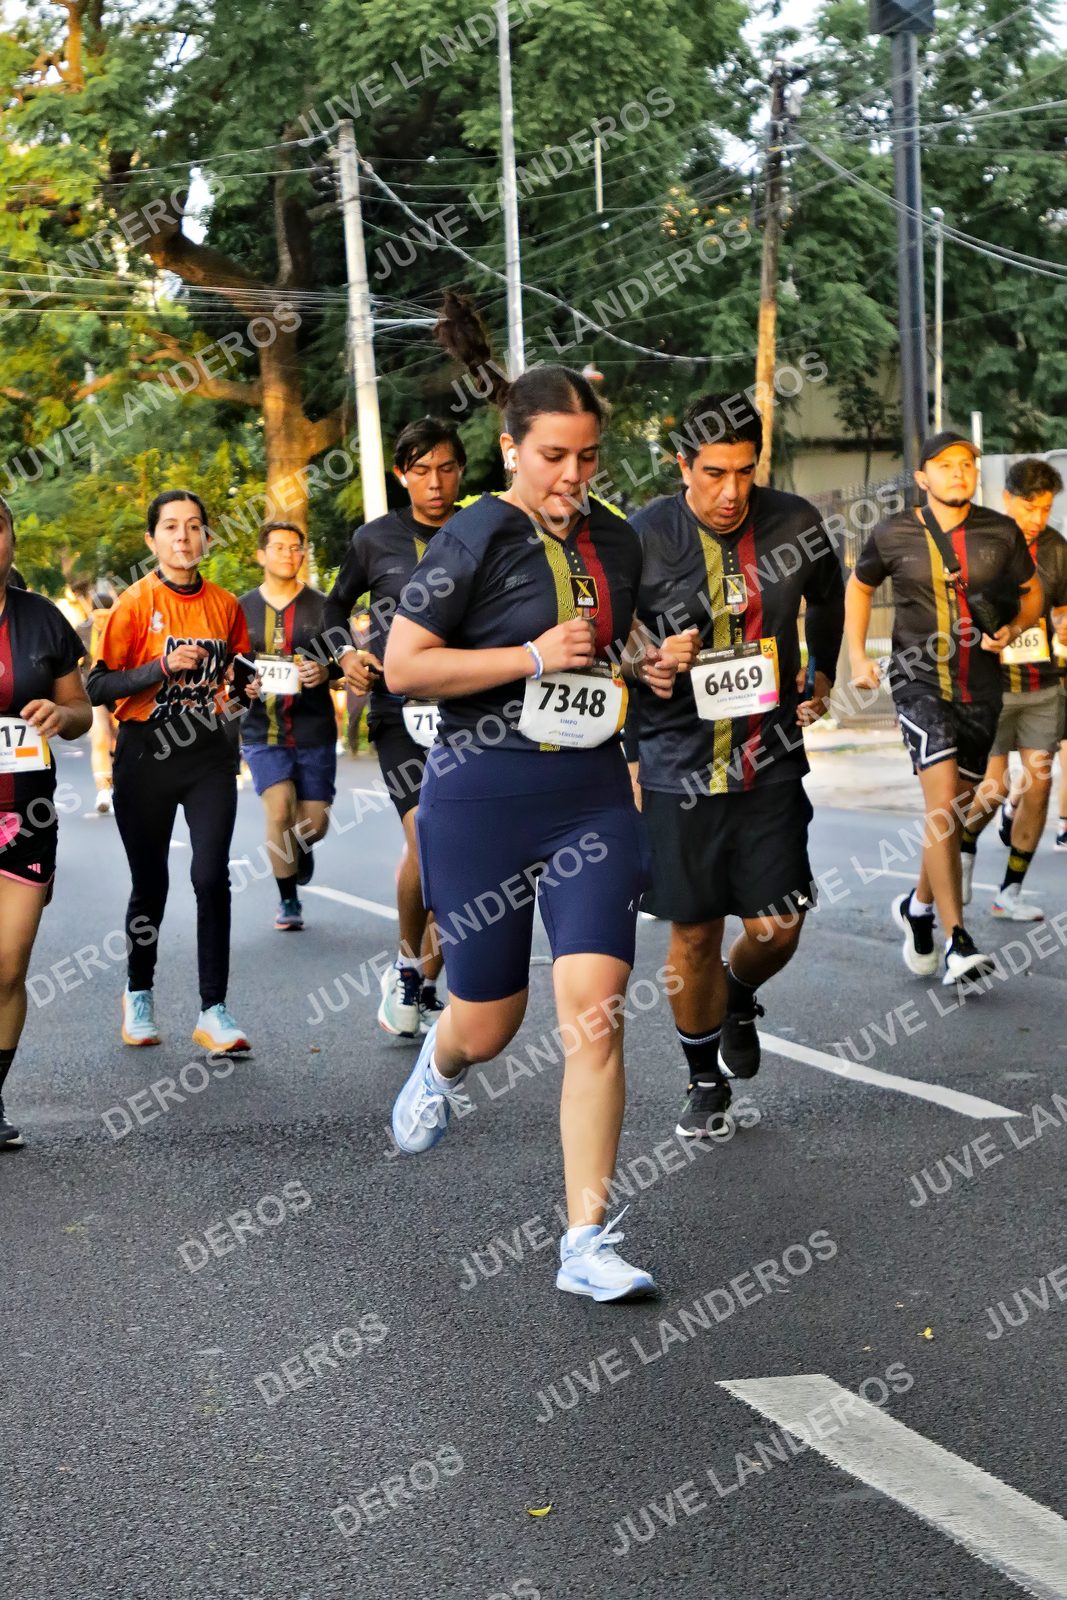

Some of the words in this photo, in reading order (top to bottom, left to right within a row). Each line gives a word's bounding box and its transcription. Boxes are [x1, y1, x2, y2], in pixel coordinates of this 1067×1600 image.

[763, 645, 774, 653] 5K
[261, 665, 292, 680] 7417
[705, 665, 763, 696] 6469
[538, 681, 607, 718] 7348
[413, 712, 442, 731] 71
